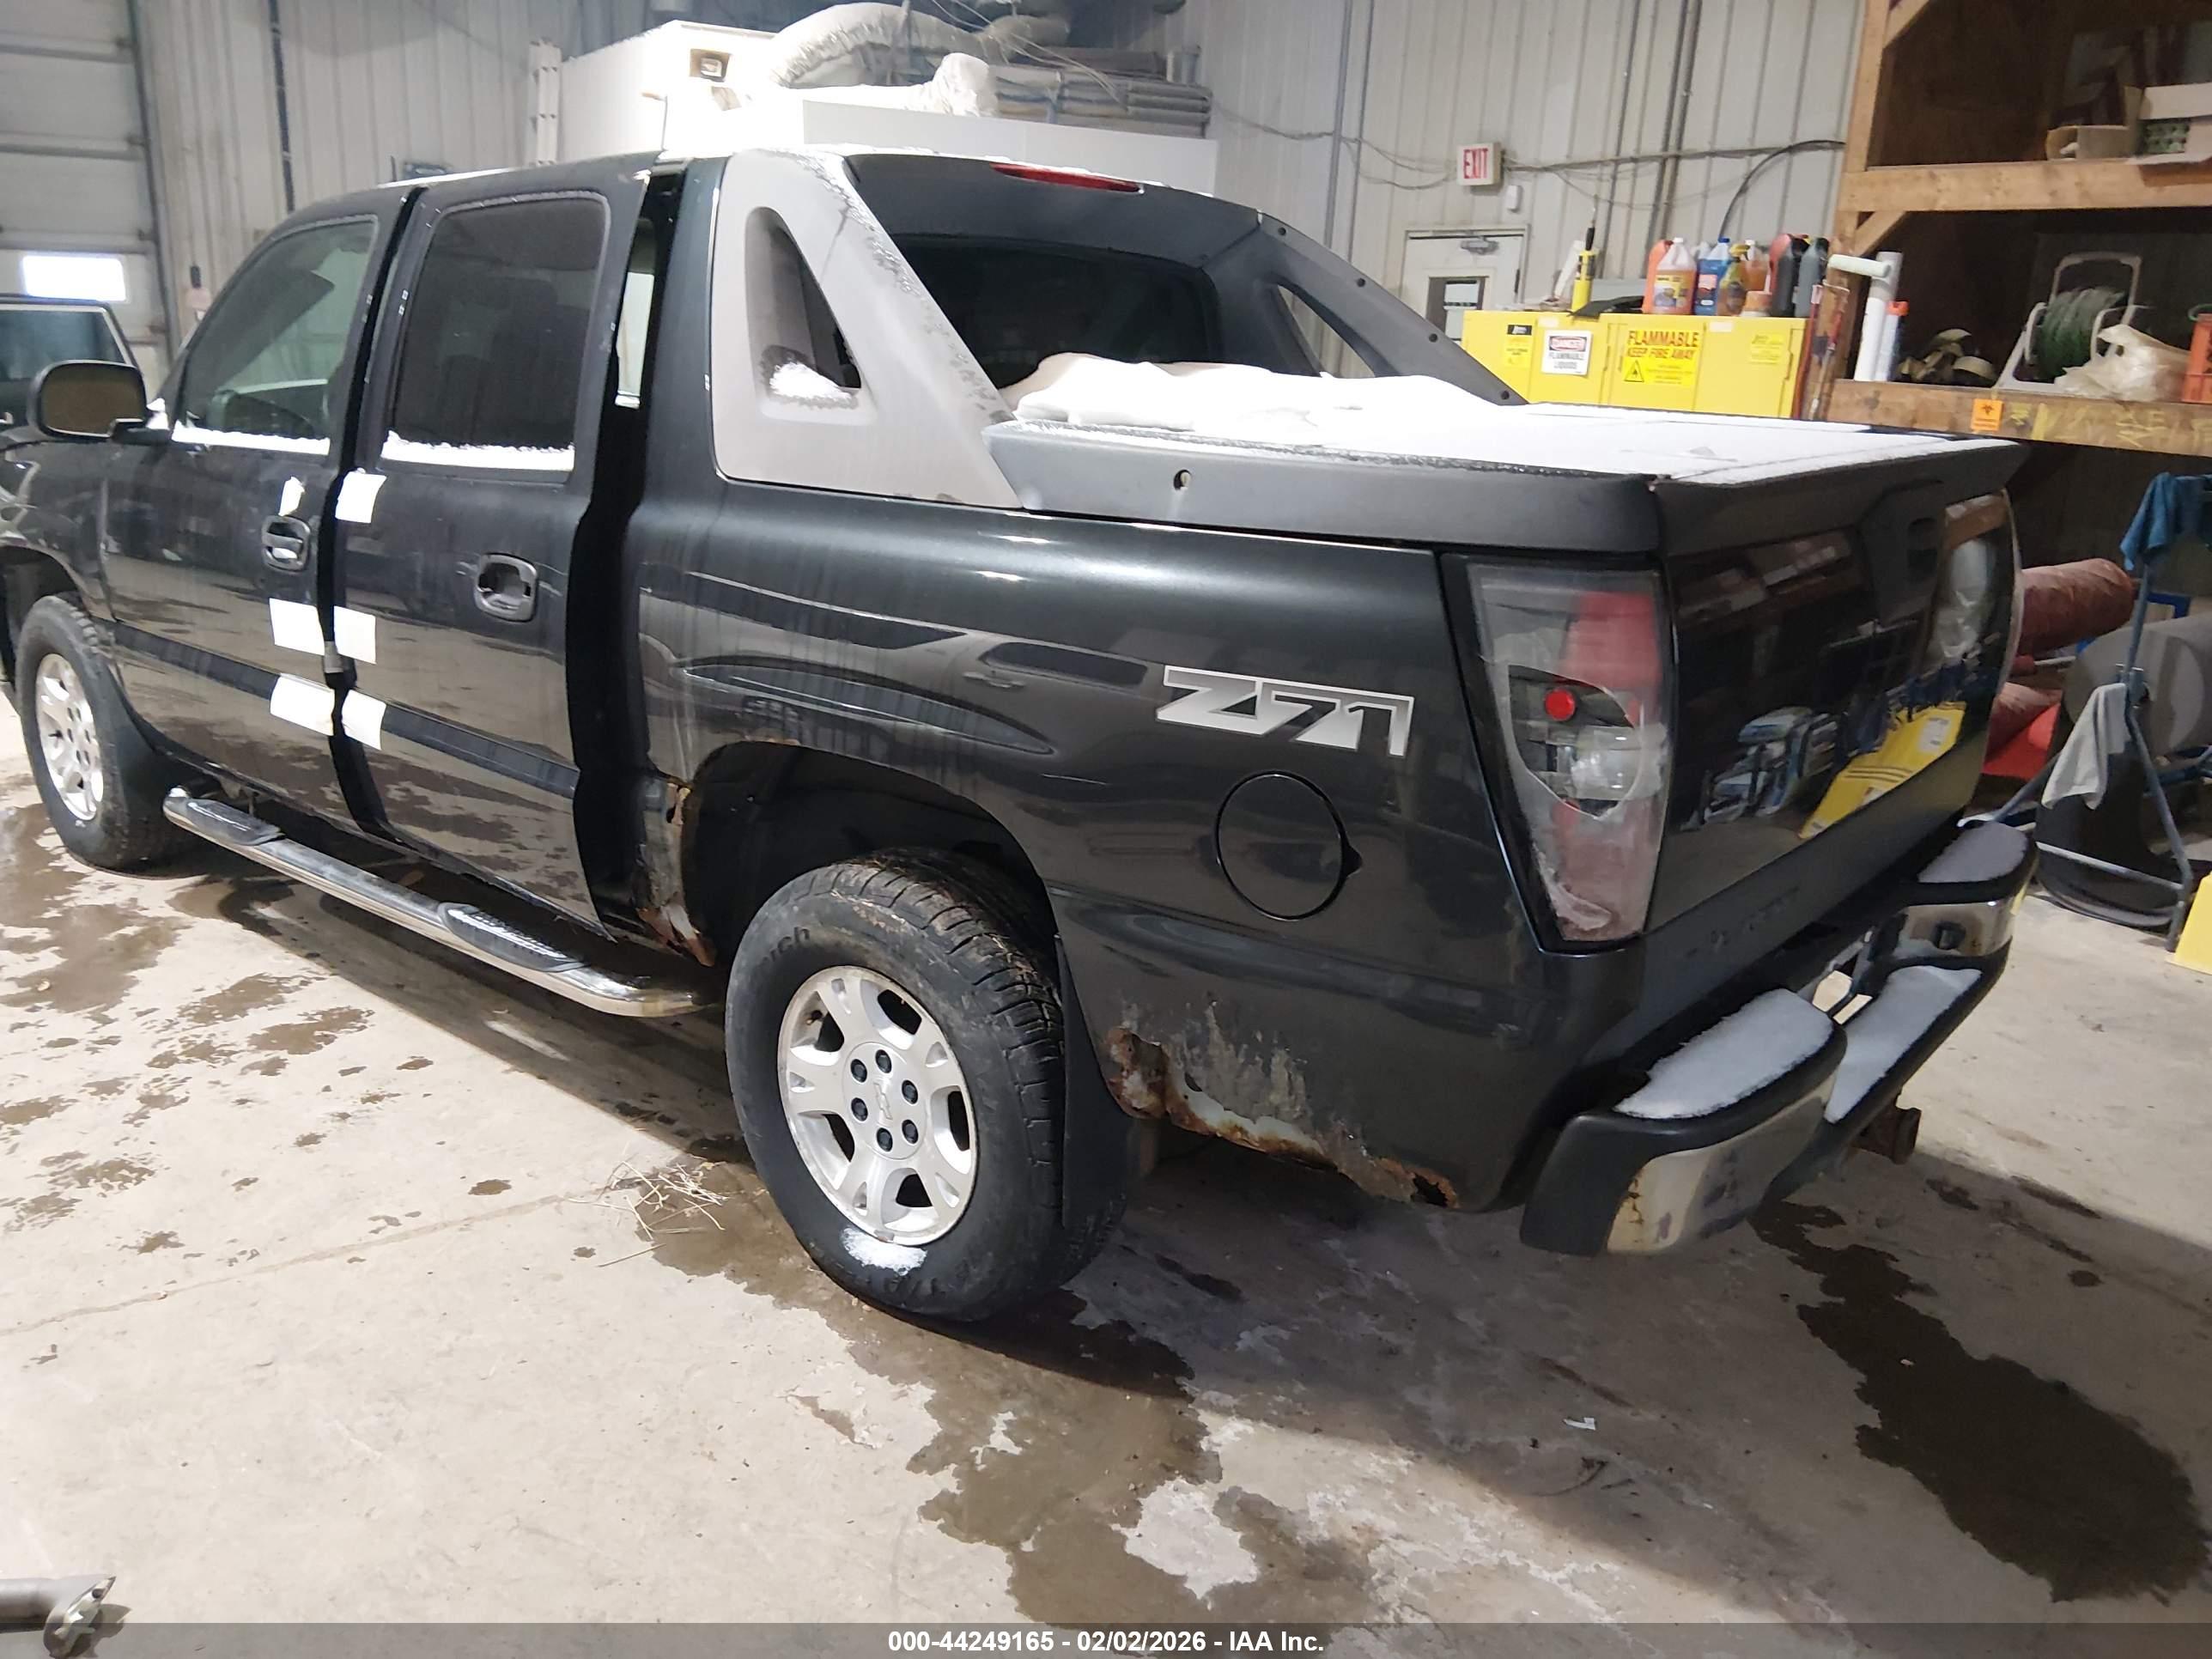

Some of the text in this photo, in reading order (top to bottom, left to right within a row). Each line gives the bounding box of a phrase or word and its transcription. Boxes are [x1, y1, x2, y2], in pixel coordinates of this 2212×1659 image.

[1463, 148, 1488, 179] EXIT
[1628, 330, 1699, 347] FLAMMABLE
[1627, 347, 1648, 357] KEEP
[1157, 665, 1414, 757] Z71
